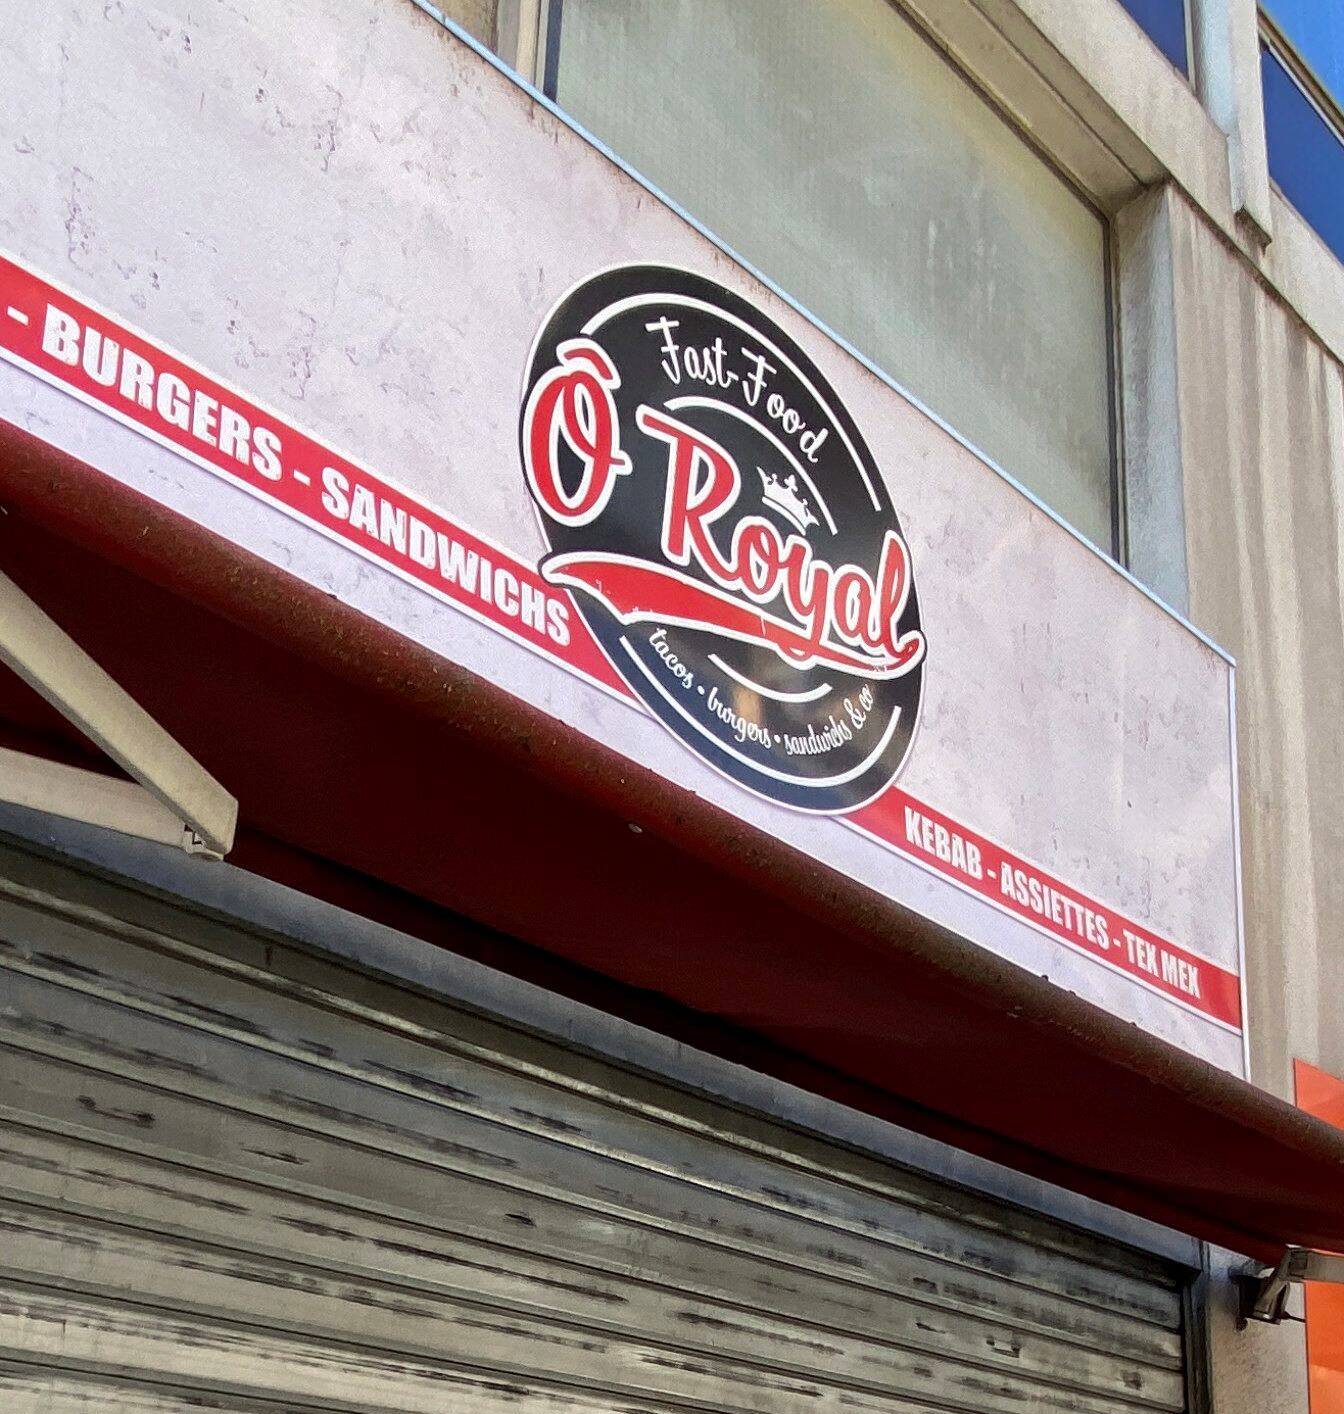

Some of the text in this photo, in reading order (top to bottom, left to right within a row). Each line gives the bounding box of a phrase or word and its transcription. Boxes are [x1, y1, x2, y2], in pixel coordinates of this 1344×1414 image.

[42, 302, 283, 484] BURGERS
[321, 465, 571, 647] SANDWICHS
[645, 316, 828, 464] Fast-Food
[636, 403, 924, 674] Royal
[648, 626, 693, 690] tacos
[707, 686, 772, 750] burgers
[783, 714, 853, 757] sandwichs
[844, 697, 867, 731] &
[903, 804, 983, 881] KEBAB
[1000, 860, 1111, 951] ASSIETTES
[1122, 927, 1160, 979] TEX
[1160, 949, 1202, 1000] MEX
